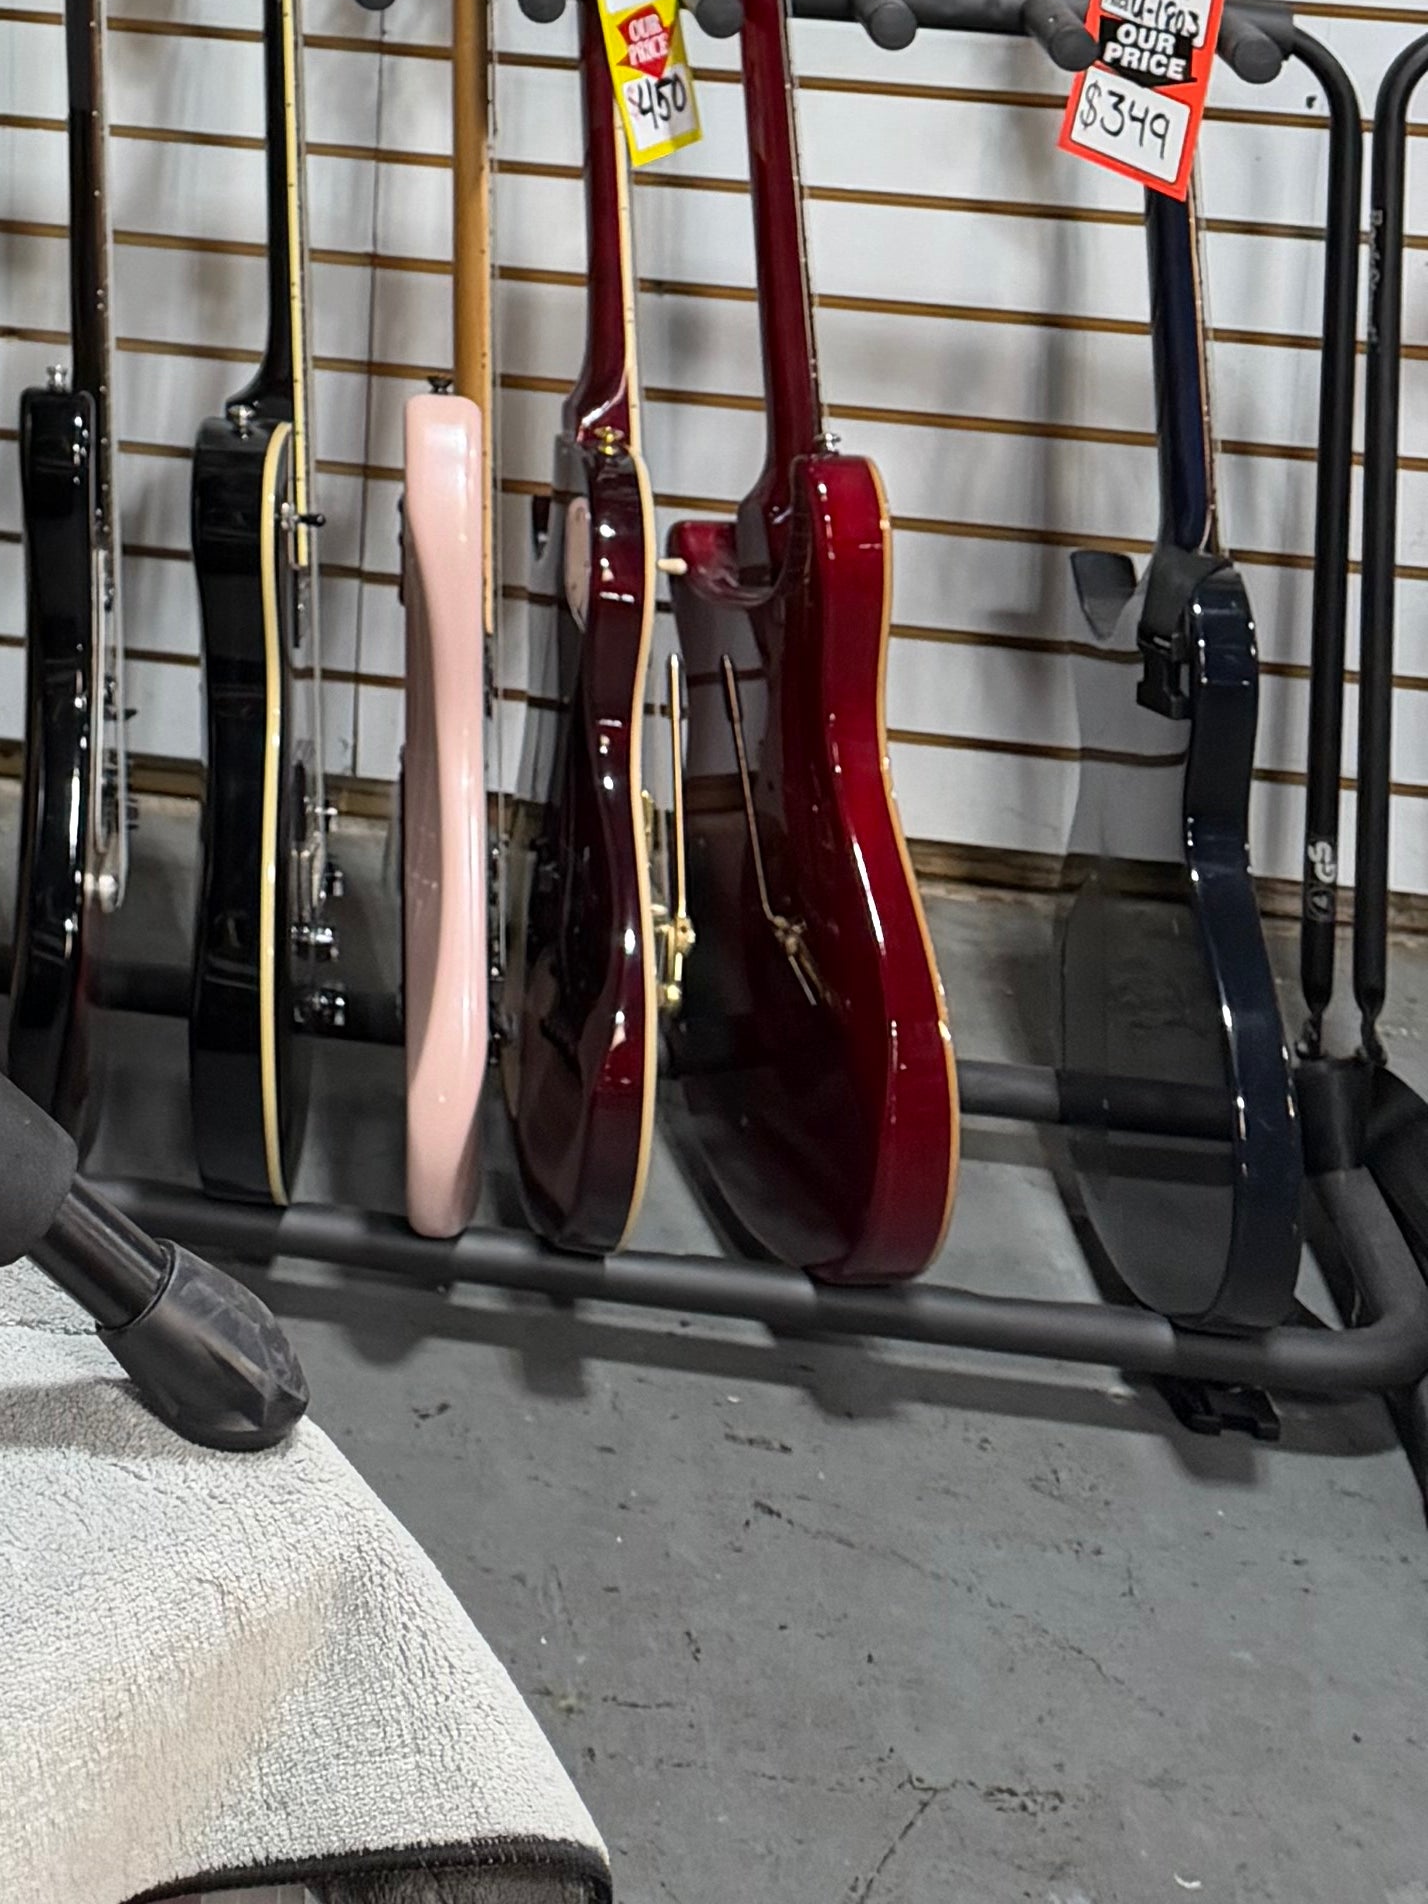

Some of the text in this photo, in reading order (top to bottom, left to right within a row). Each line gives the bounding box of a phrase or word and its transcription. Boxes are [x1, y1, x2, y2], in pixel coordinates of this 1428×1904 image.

[628, 13, 663, 43] OUR
[1116, 22, 1177, 56] OUR
[628, 32, 669, 67] PRICE
[1103, 41, 1187, 82] PRICE
[1079, 79, 1171, 160] $349
